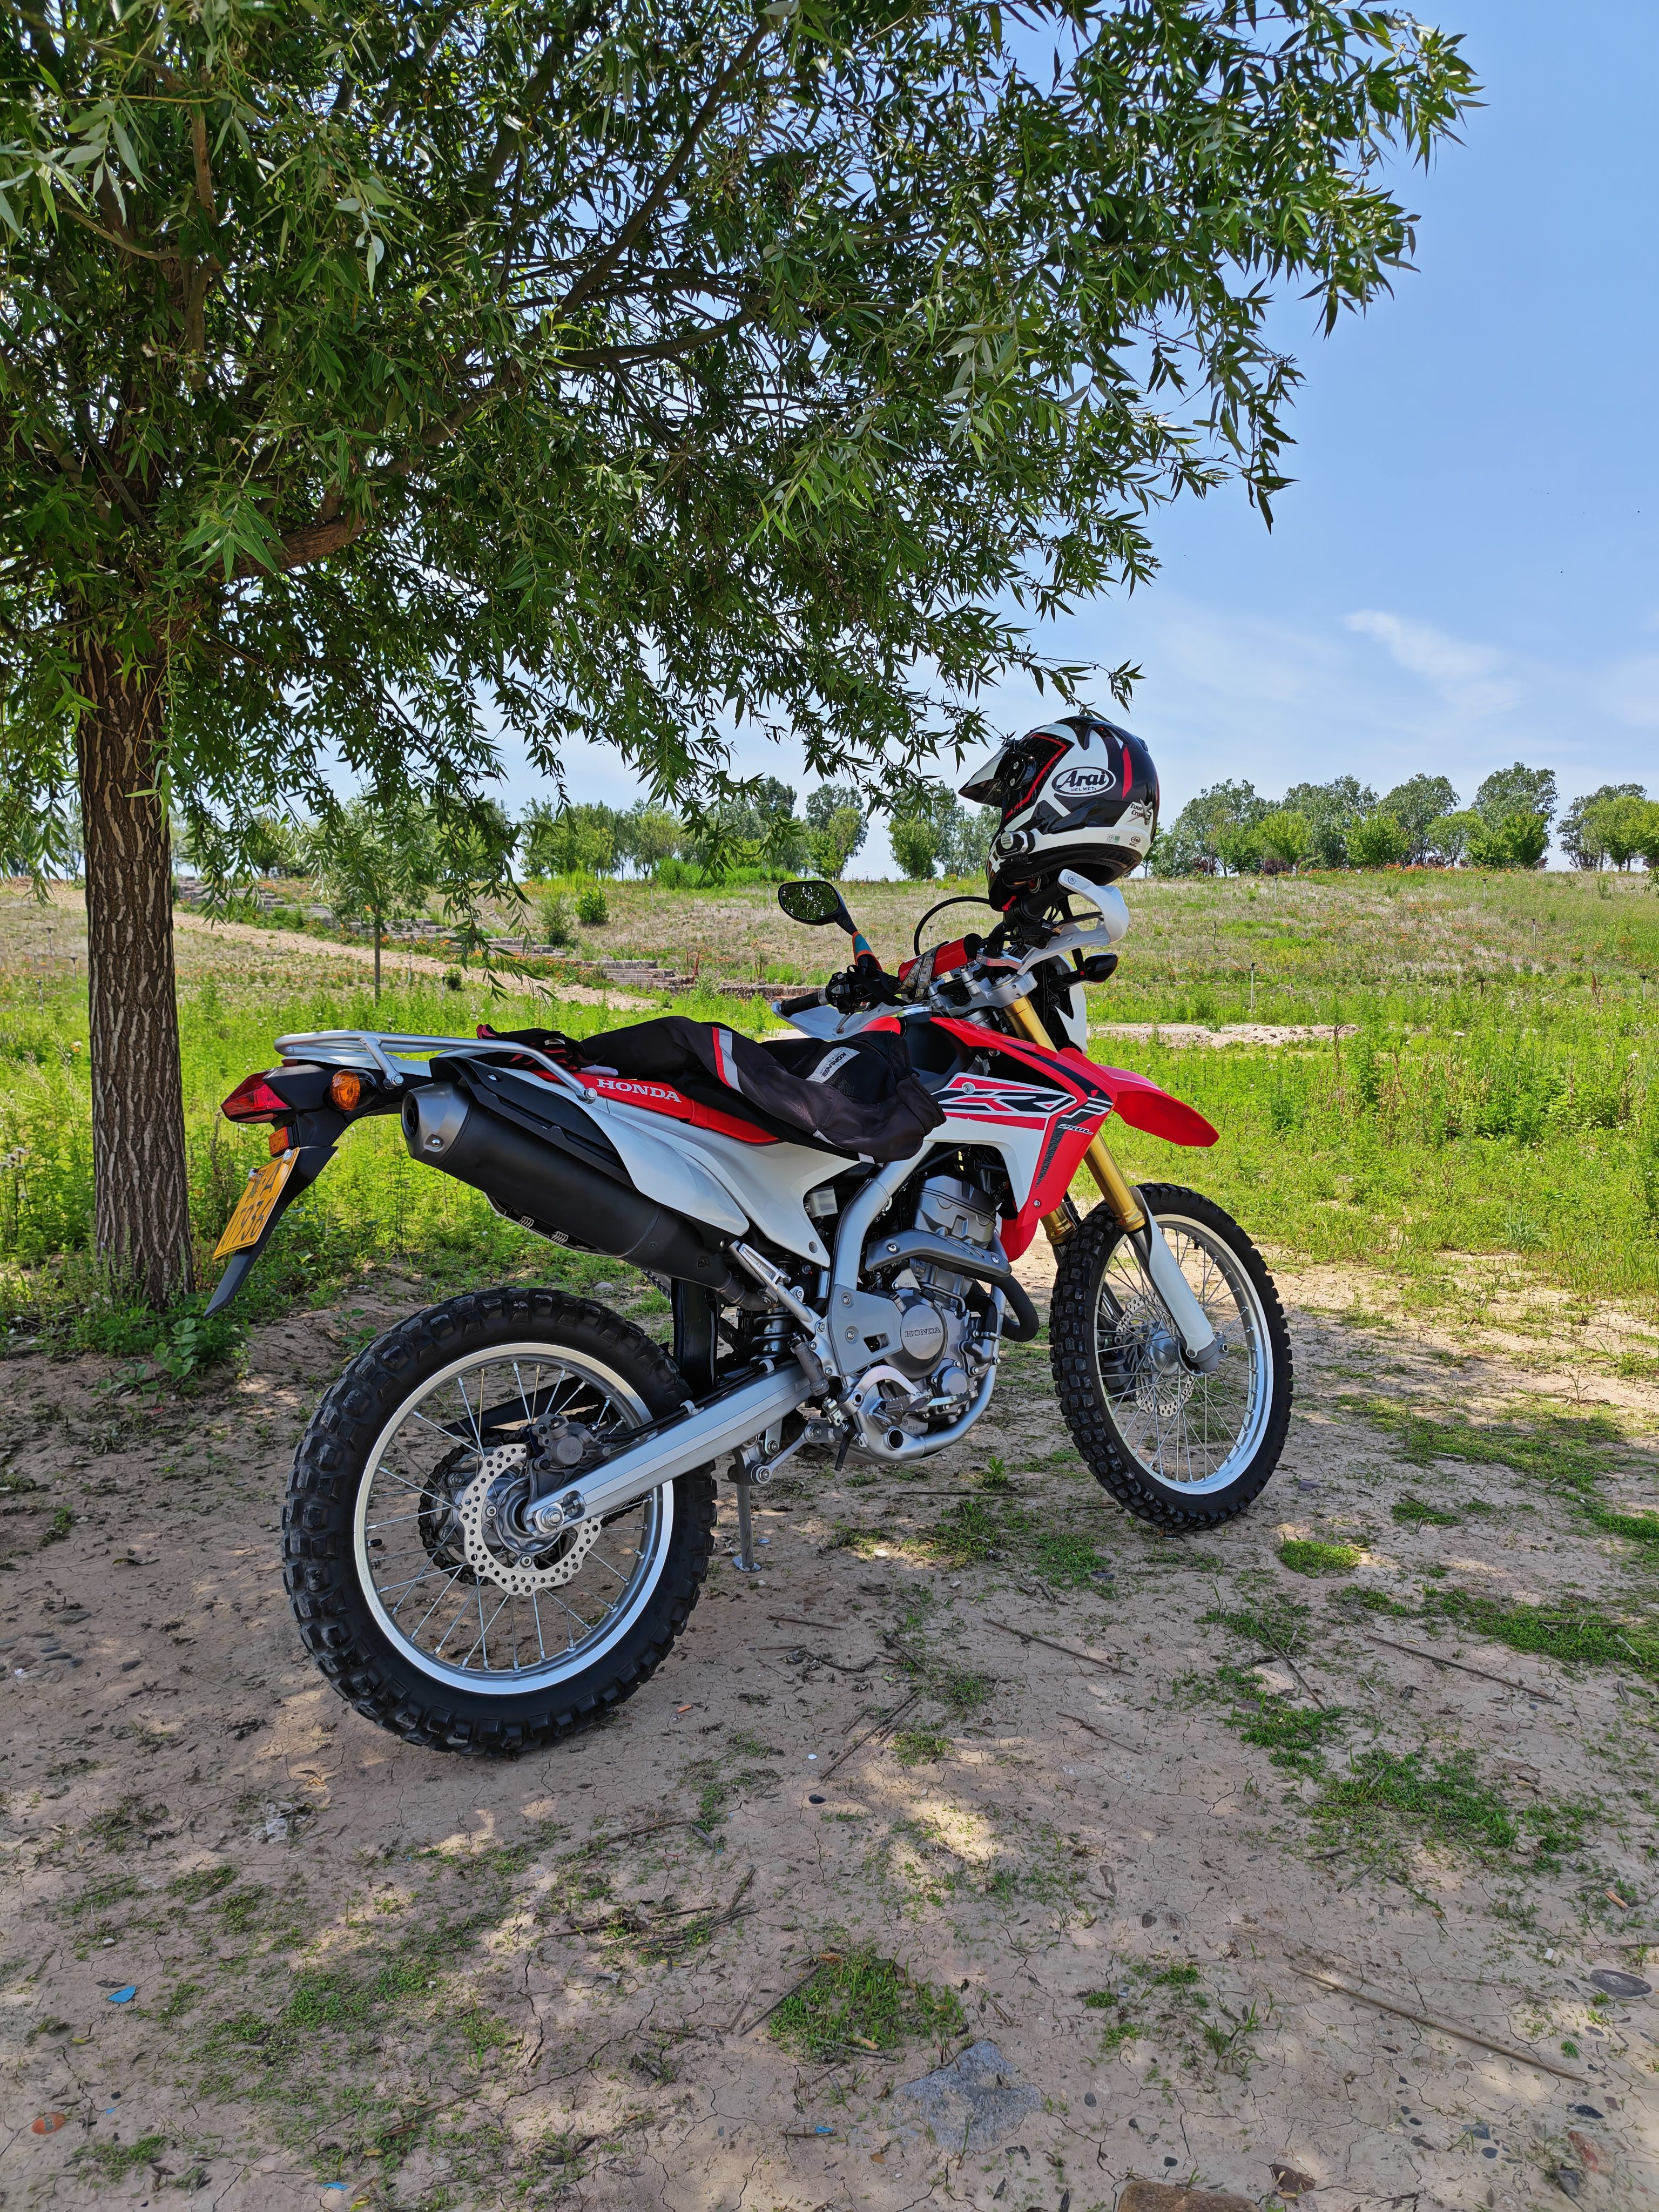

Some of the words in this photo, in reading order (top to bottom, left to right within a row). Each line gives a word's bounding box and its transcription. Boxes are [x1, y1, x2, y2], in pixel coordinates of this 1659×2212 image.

[1055, 770, 1107, 789] Arai
[596, 1078, 682, 1103] HONDA
[1058, 1124, 1094, 1135] 250L
[904, 1327, 941, 1338] HONDA
